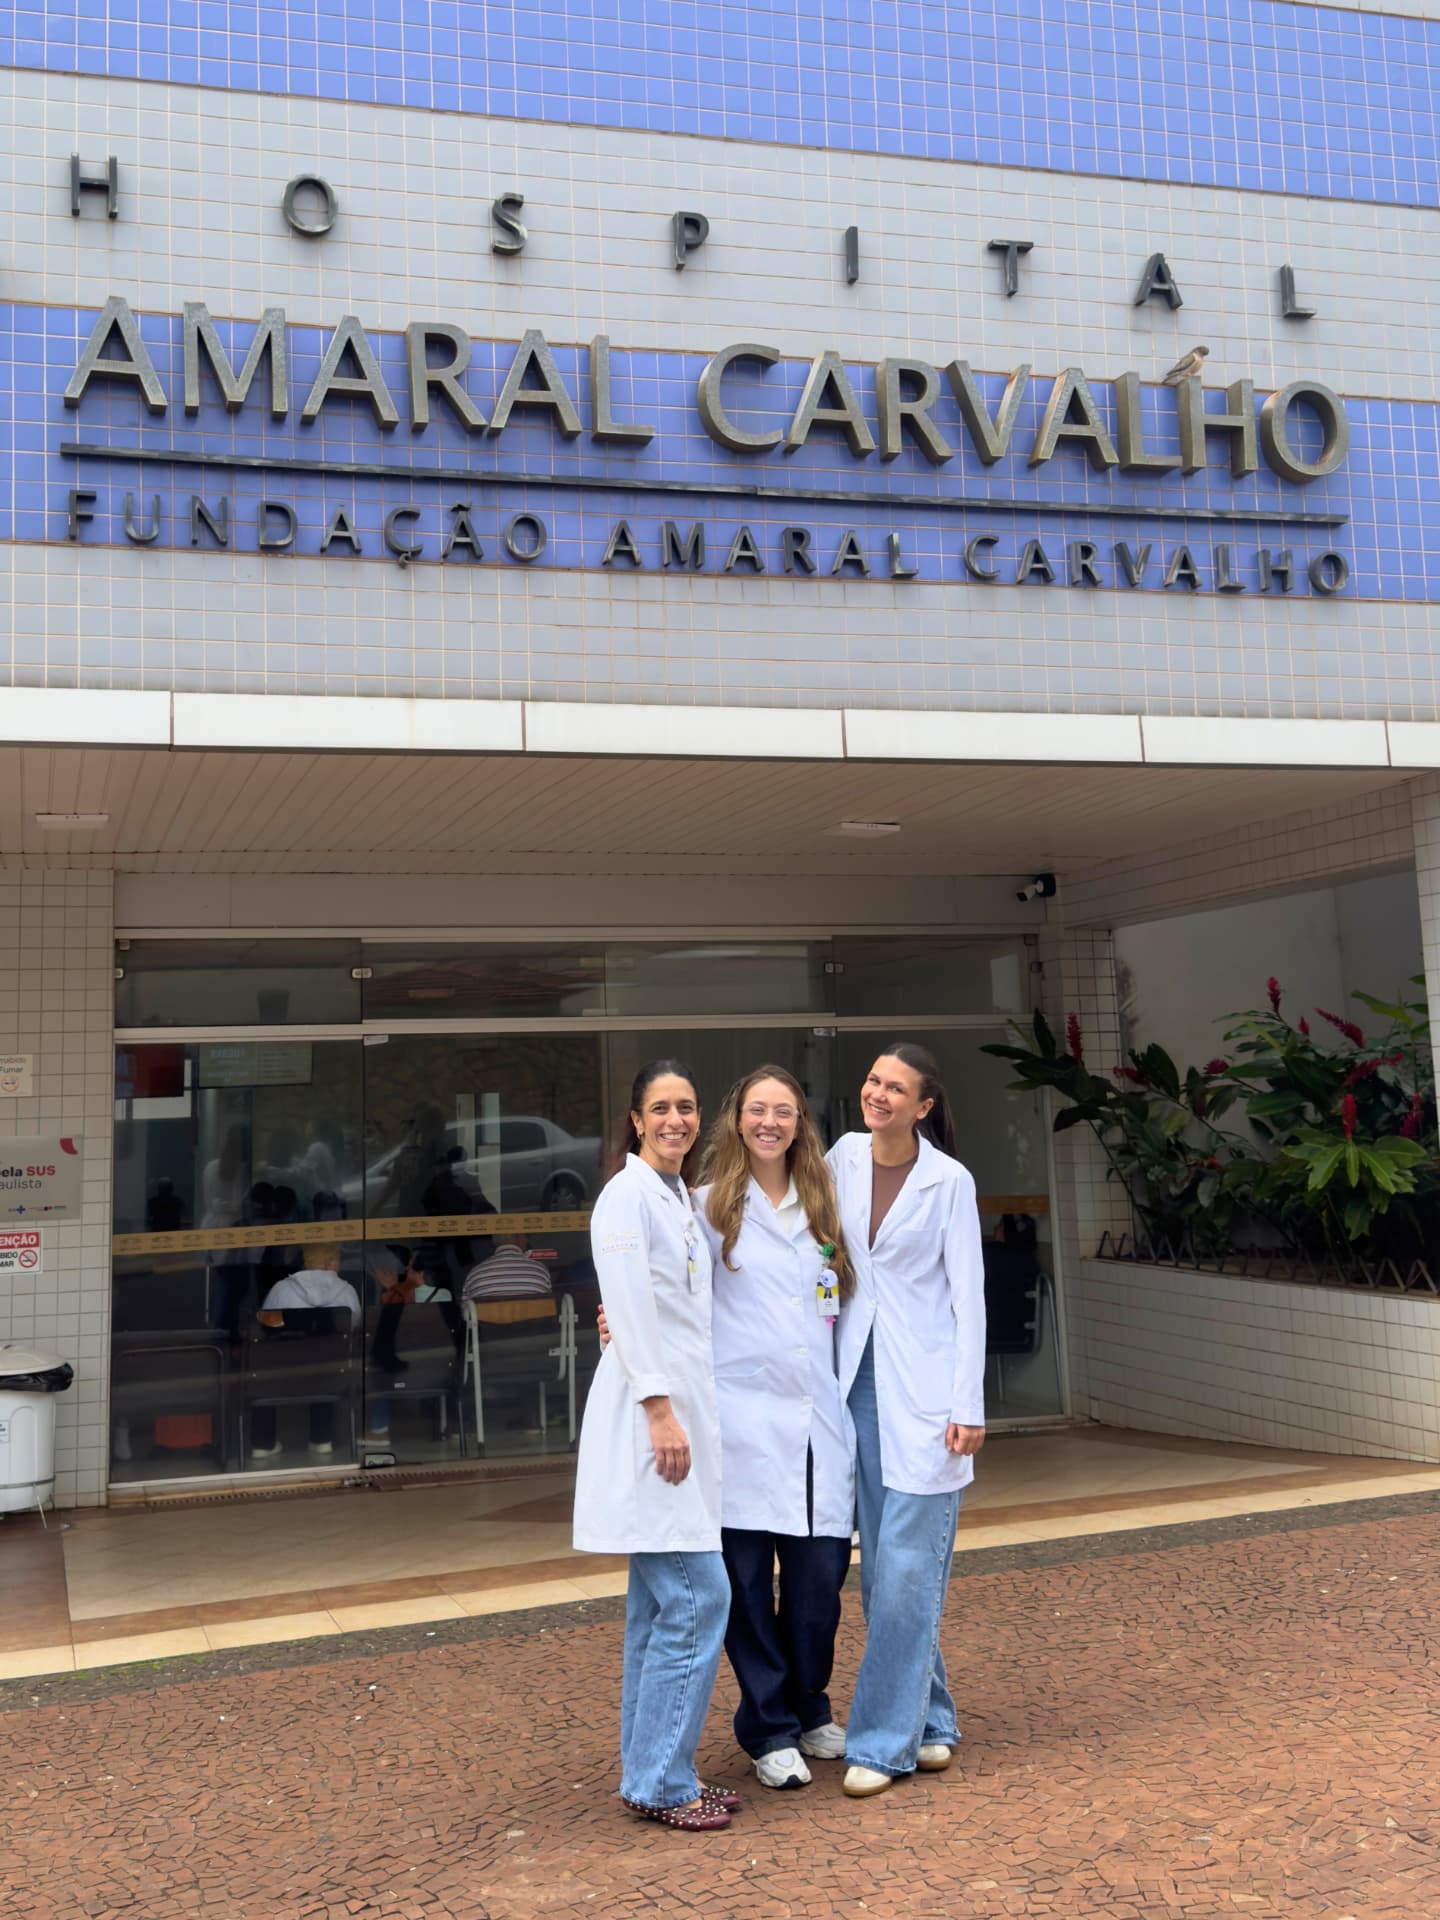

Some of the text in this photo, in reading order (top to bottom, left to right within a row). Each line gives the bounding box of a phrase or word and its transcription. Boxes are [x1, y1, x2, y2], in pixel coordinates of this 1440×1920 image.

[70, 153, 1315, 320] HOSPITAL
[63, 296, 1350, 483] AMARAL CARVALHO
[67, 489, 1350, 595] FUNDAÇÃO AMARAL CARVALHO
[0, 1165, 56, 1177] ela SUS
